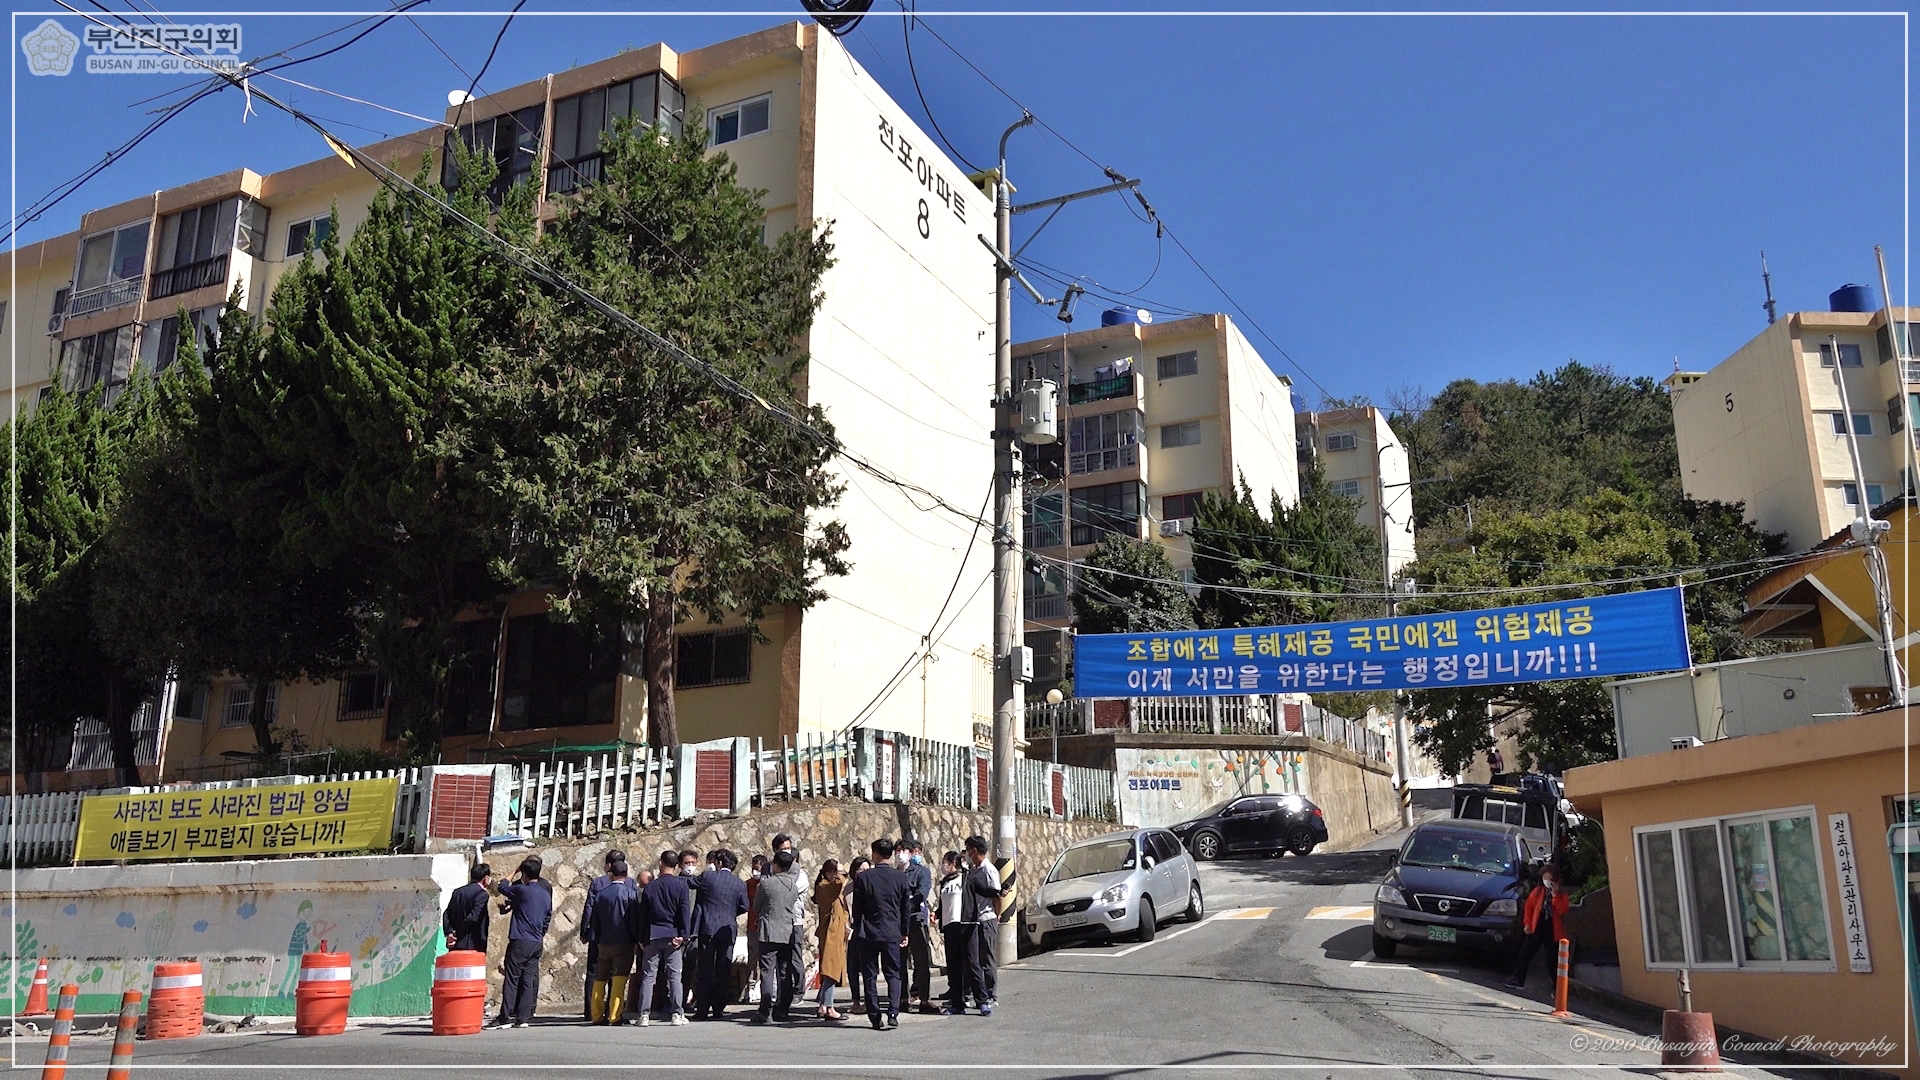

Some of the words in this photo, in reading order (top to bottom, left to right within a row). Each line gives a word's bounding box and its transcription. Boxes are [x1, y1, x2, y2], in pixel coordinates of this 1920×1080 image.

[878, 114, 966, 225] 전포아파트
[917, 198, 930, 240] 8
[1725, 392, 1734, 413] 5
[1126, 635, 1220, 662] 조합에겐
[1232, 629, 1334, 659] 특혜제공
[1347, 618, 1459, 653] 국민에겐
[1474, 605, 1594, 644] 위험제공
[1126, 667, 1172, 692] 이게
[1186, 664, 1261, 691] 서민을
[1277, 660, 1386, 688] 위한다는
[1403, 641, 1597, 684] 행정입니까!!!
[1128, 779, 1182, 791] 전포아파트
[113, 798, 162, 824] 사라진
[168, 796, 202, 820] 보도
[208, 791, 262, 819] 사라진
[269, 790, 305, 816] 법과
[313, 787, 351, 813] 양심
[110, 828, 177, 853] 애들보기
[183, 824, 254, 851] 부끄럽지
[263, 820, 347, 848] 않습니까!
